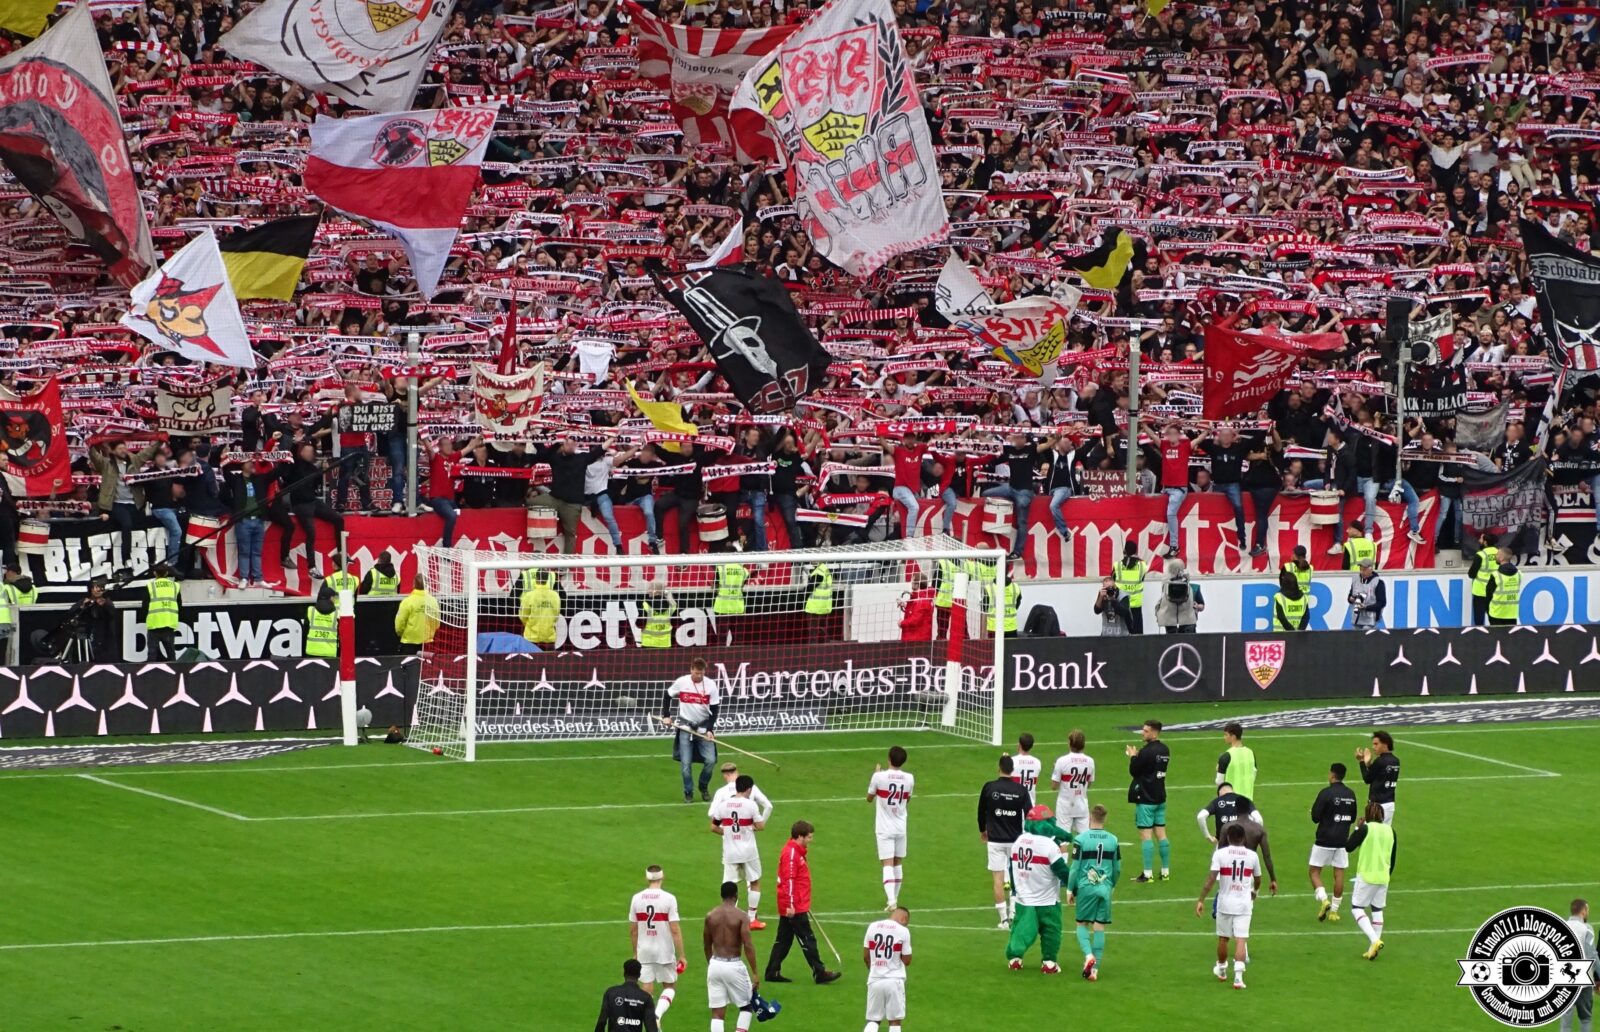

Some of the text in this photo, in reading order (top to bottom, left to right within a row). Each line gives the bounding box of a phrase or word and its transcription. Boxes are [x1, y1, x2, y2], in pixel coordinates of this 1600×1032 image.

[932, 49, 992, 58] VfB STUTTGART
[847, 328, 895, 337] STUTTGART
[354, 404, 396, 414] DU BIST
[1422, 399, 1434, 410] in
[159, 415, 230, 430] STUTTGART
[353, 414, 395, 424] IMMER
[353, 423, 395, 432] BEI UNS!
[888, 423, 908, 432] CC
[429, 426, 482, 435] COMMANDO
[1083, 470, 1119, 481] ULTRA
[823, 494, 876, 505] Commando
[1472, 508, 1543, 530] ULTRAS
[44, 526, 169, 583] BLEIBT
[122, 610, 304, 663] betwa
[315, 630, 330, 638] 2367
[714, 652, 1108, 700] Mercedes-Benz Bank
[475, 717, 641, 736] Mercedes-Benz Bank
[781, 711, 822, 725] Bank
[1020, 769, 1034, 791] 15
[1069, 766, 1089, 789] 24
[887, 783, 905, 806] 21
[731, 811, 741, 834] 3
[1017, 847, 1034, 871] 92
[1096, 843, 1104, 865] 1
[1231, 859, 1246, 883] 11
[646, 904, 656, 930] 2
[873, 933, 894, 961] 28
[625, 1018, 641, 1026] JAKO
